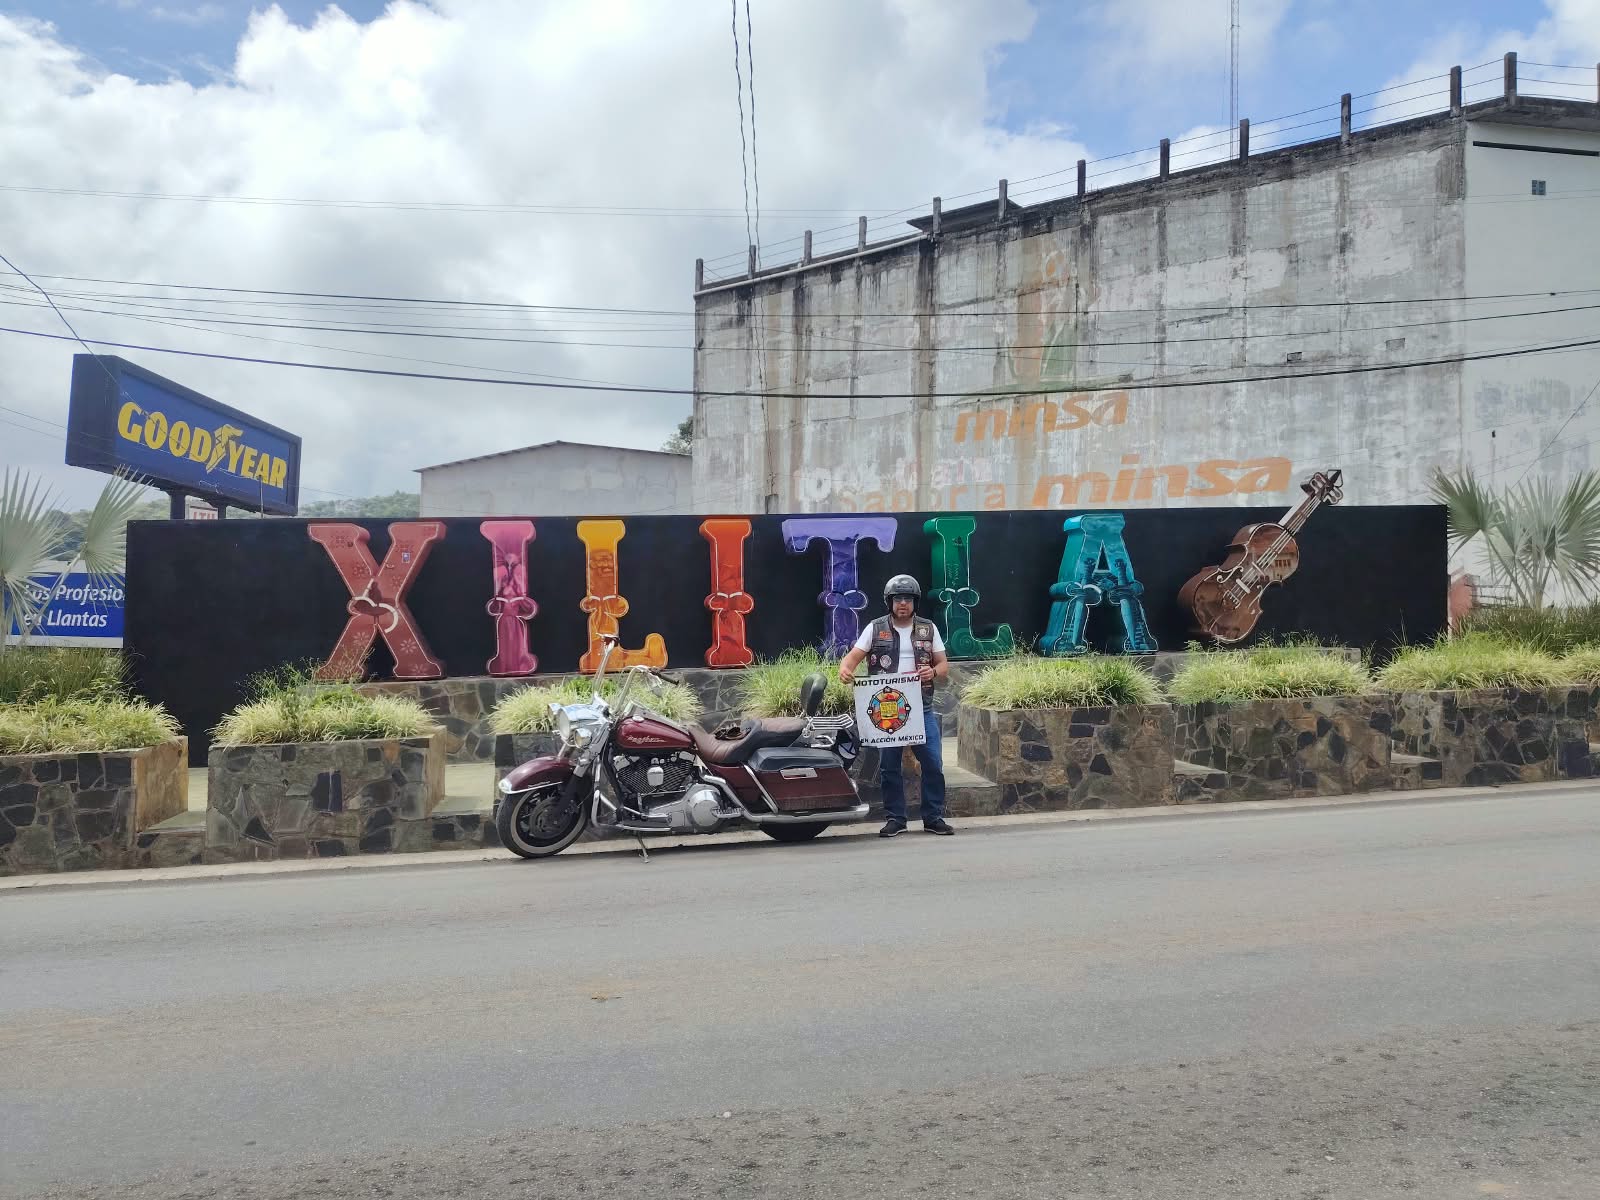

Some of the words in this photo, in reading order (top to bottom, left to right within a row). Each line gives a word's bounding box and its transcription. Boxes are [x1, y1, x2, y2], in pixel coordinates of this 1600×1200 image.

[954, 391, 1129, 444] minsa
[117, 402, 288, 489] GOODYEAR
[1032, 454, 1292, 507] minsa
[55, 583, 125, 606] Profesio
[307, 512, 1159, 682] XILITLA
[47, 609, 108, 628] Llantas
[853, 674, 920, 688] MOTOTURISMO
[870, 735, 896, 744] ACCIÓN
